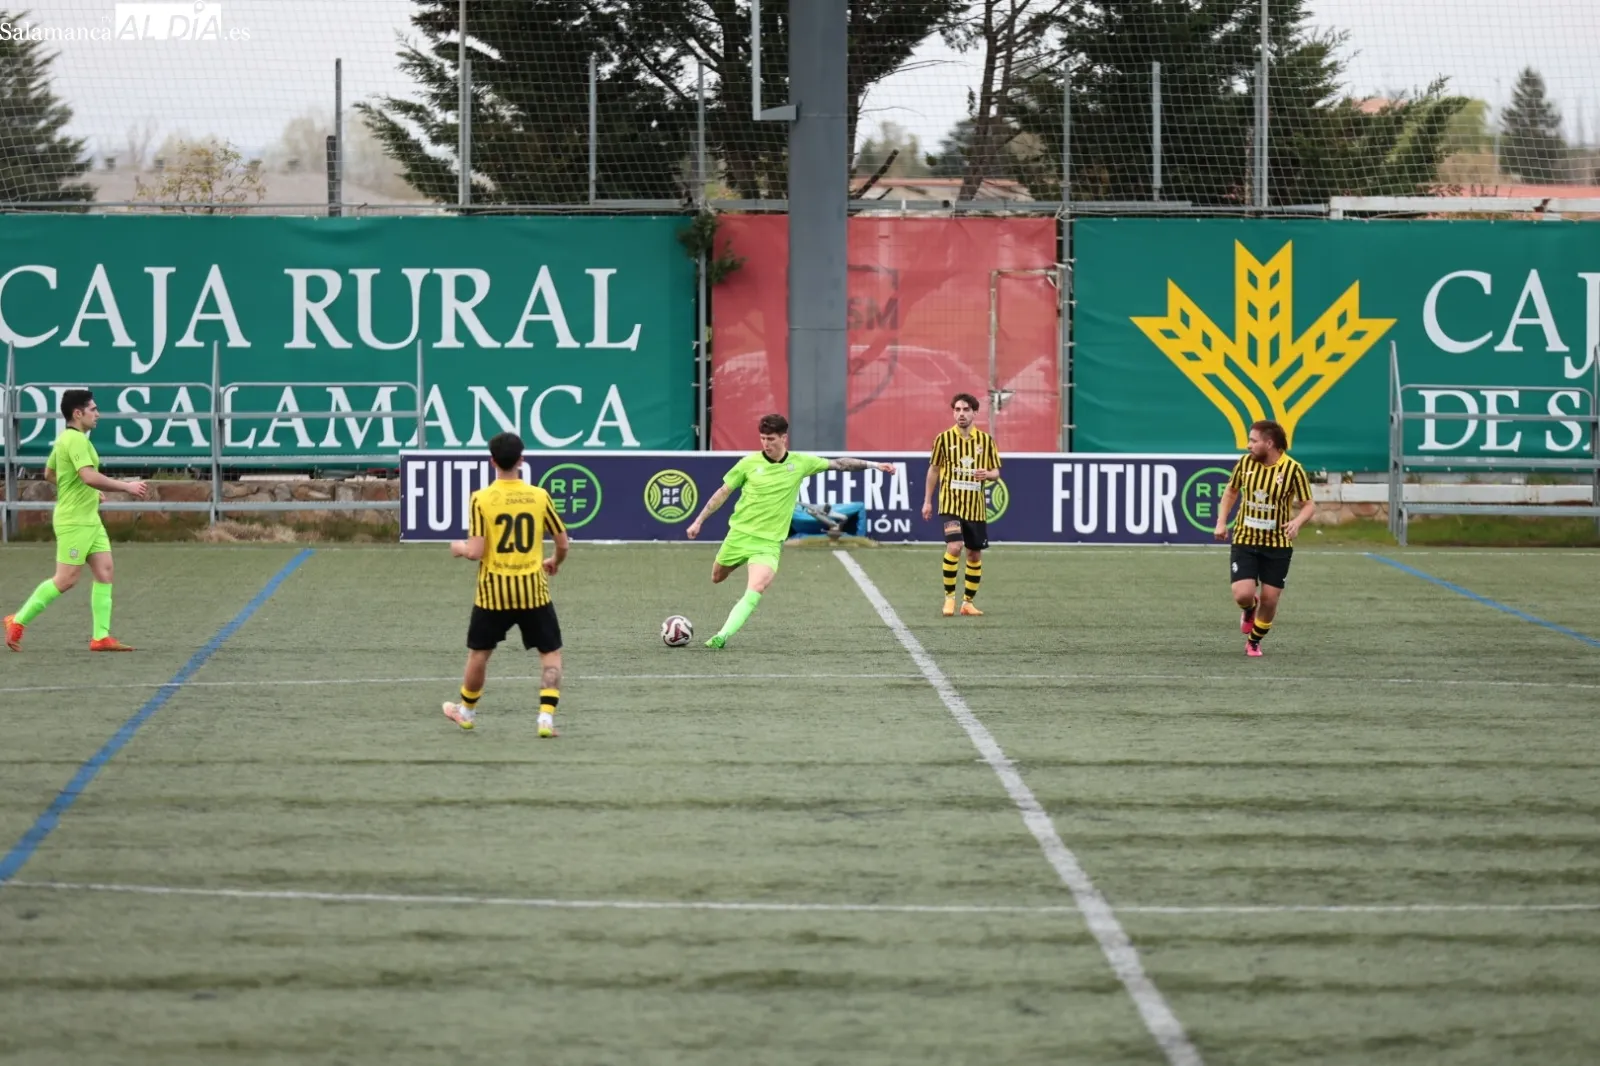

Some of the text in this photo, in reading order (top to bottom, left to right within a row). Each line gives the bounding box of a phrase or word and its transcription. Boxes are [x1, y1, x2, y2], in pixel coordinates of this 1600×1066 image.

[0, 264, 642, 374] CAJA RURAL
[1423, 269, 1600, 379] CAJ
[115, 384, 641, 449] SALAMANCA
[1418, 390, 1591, 452] DE S
[495, 512, 535, 554] 20
[1052, 463, 1178, 535] FUTUR
